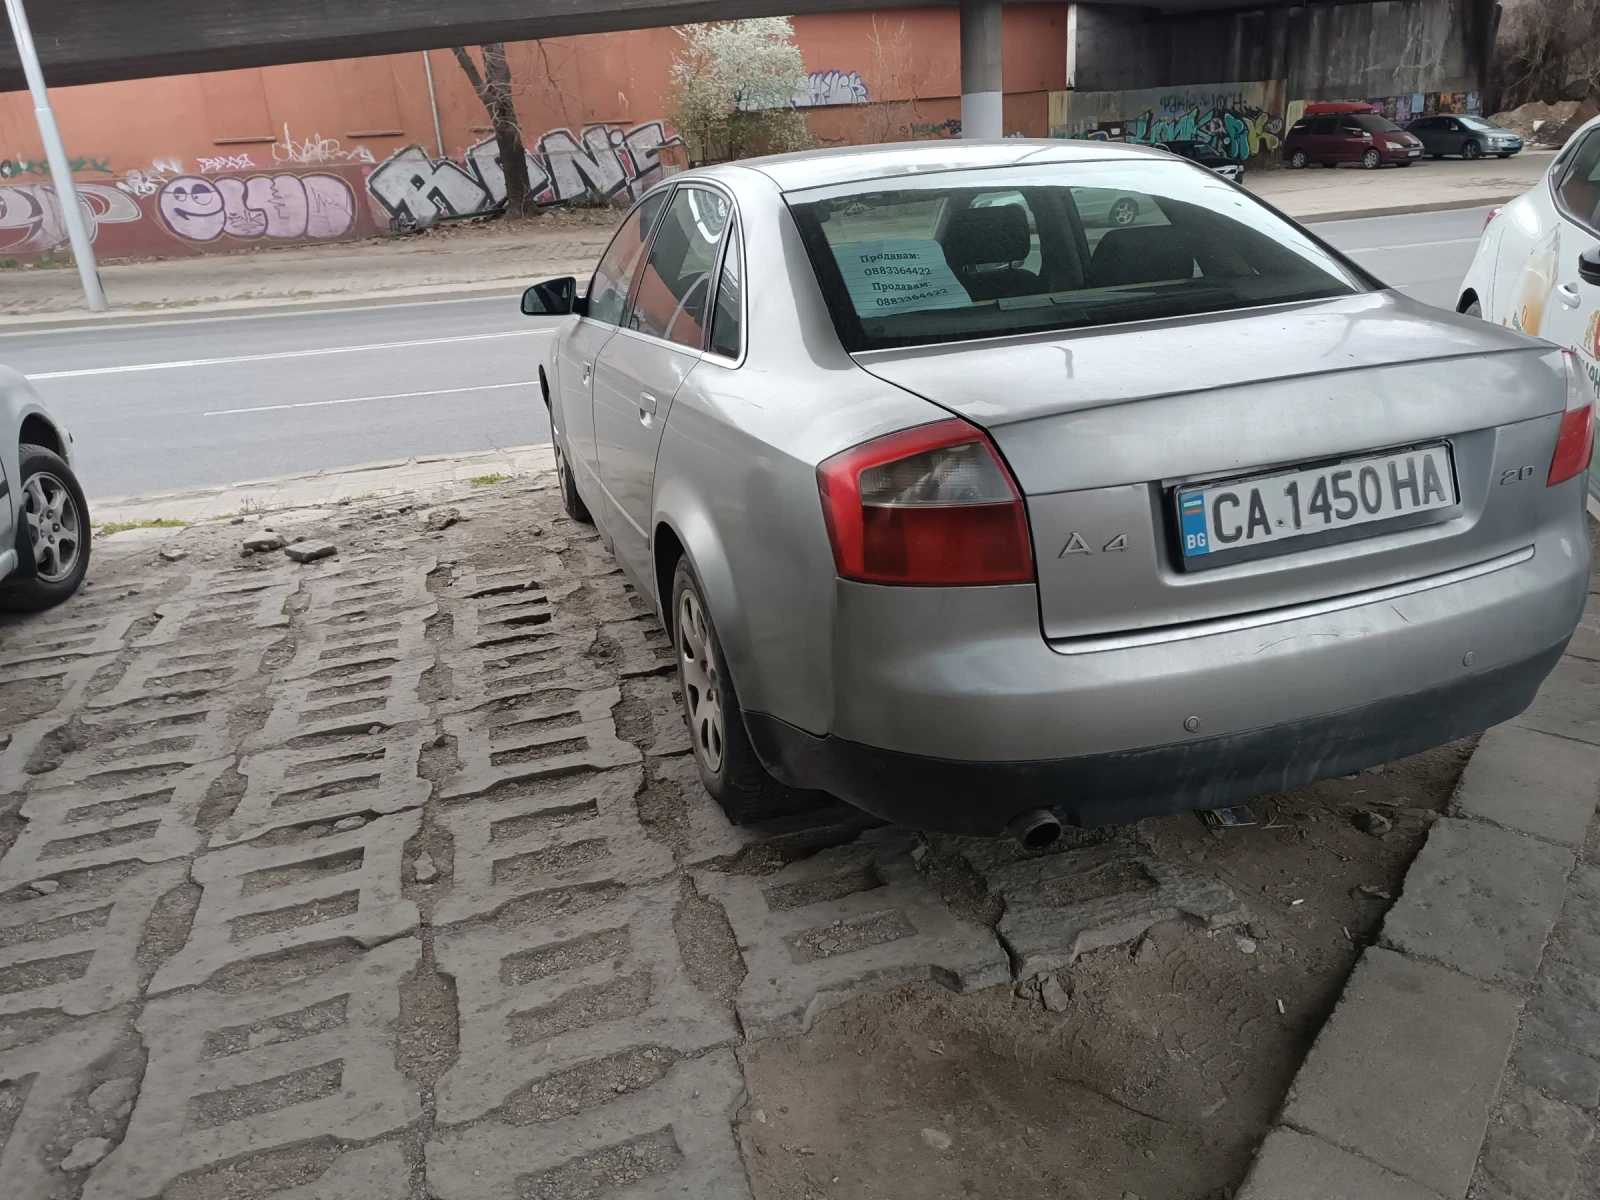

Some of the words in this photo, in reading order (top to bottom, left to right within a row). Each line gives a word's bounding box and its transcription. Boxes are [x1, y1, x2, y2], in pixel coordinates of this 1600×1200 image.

[859, 252, 921, 263] Продавам:
[864, 266, 932, 277] 0883364422
[871, 280, 933, 292] Продавам:
[876, 288, 949, 307] 0883364422
[1212, 487, 1273, 545] CA
[1284, 464, 1383, 531] 1450
[1387, 454, 1447, 511] HA
[1186, 532, 1207, 549] BG
